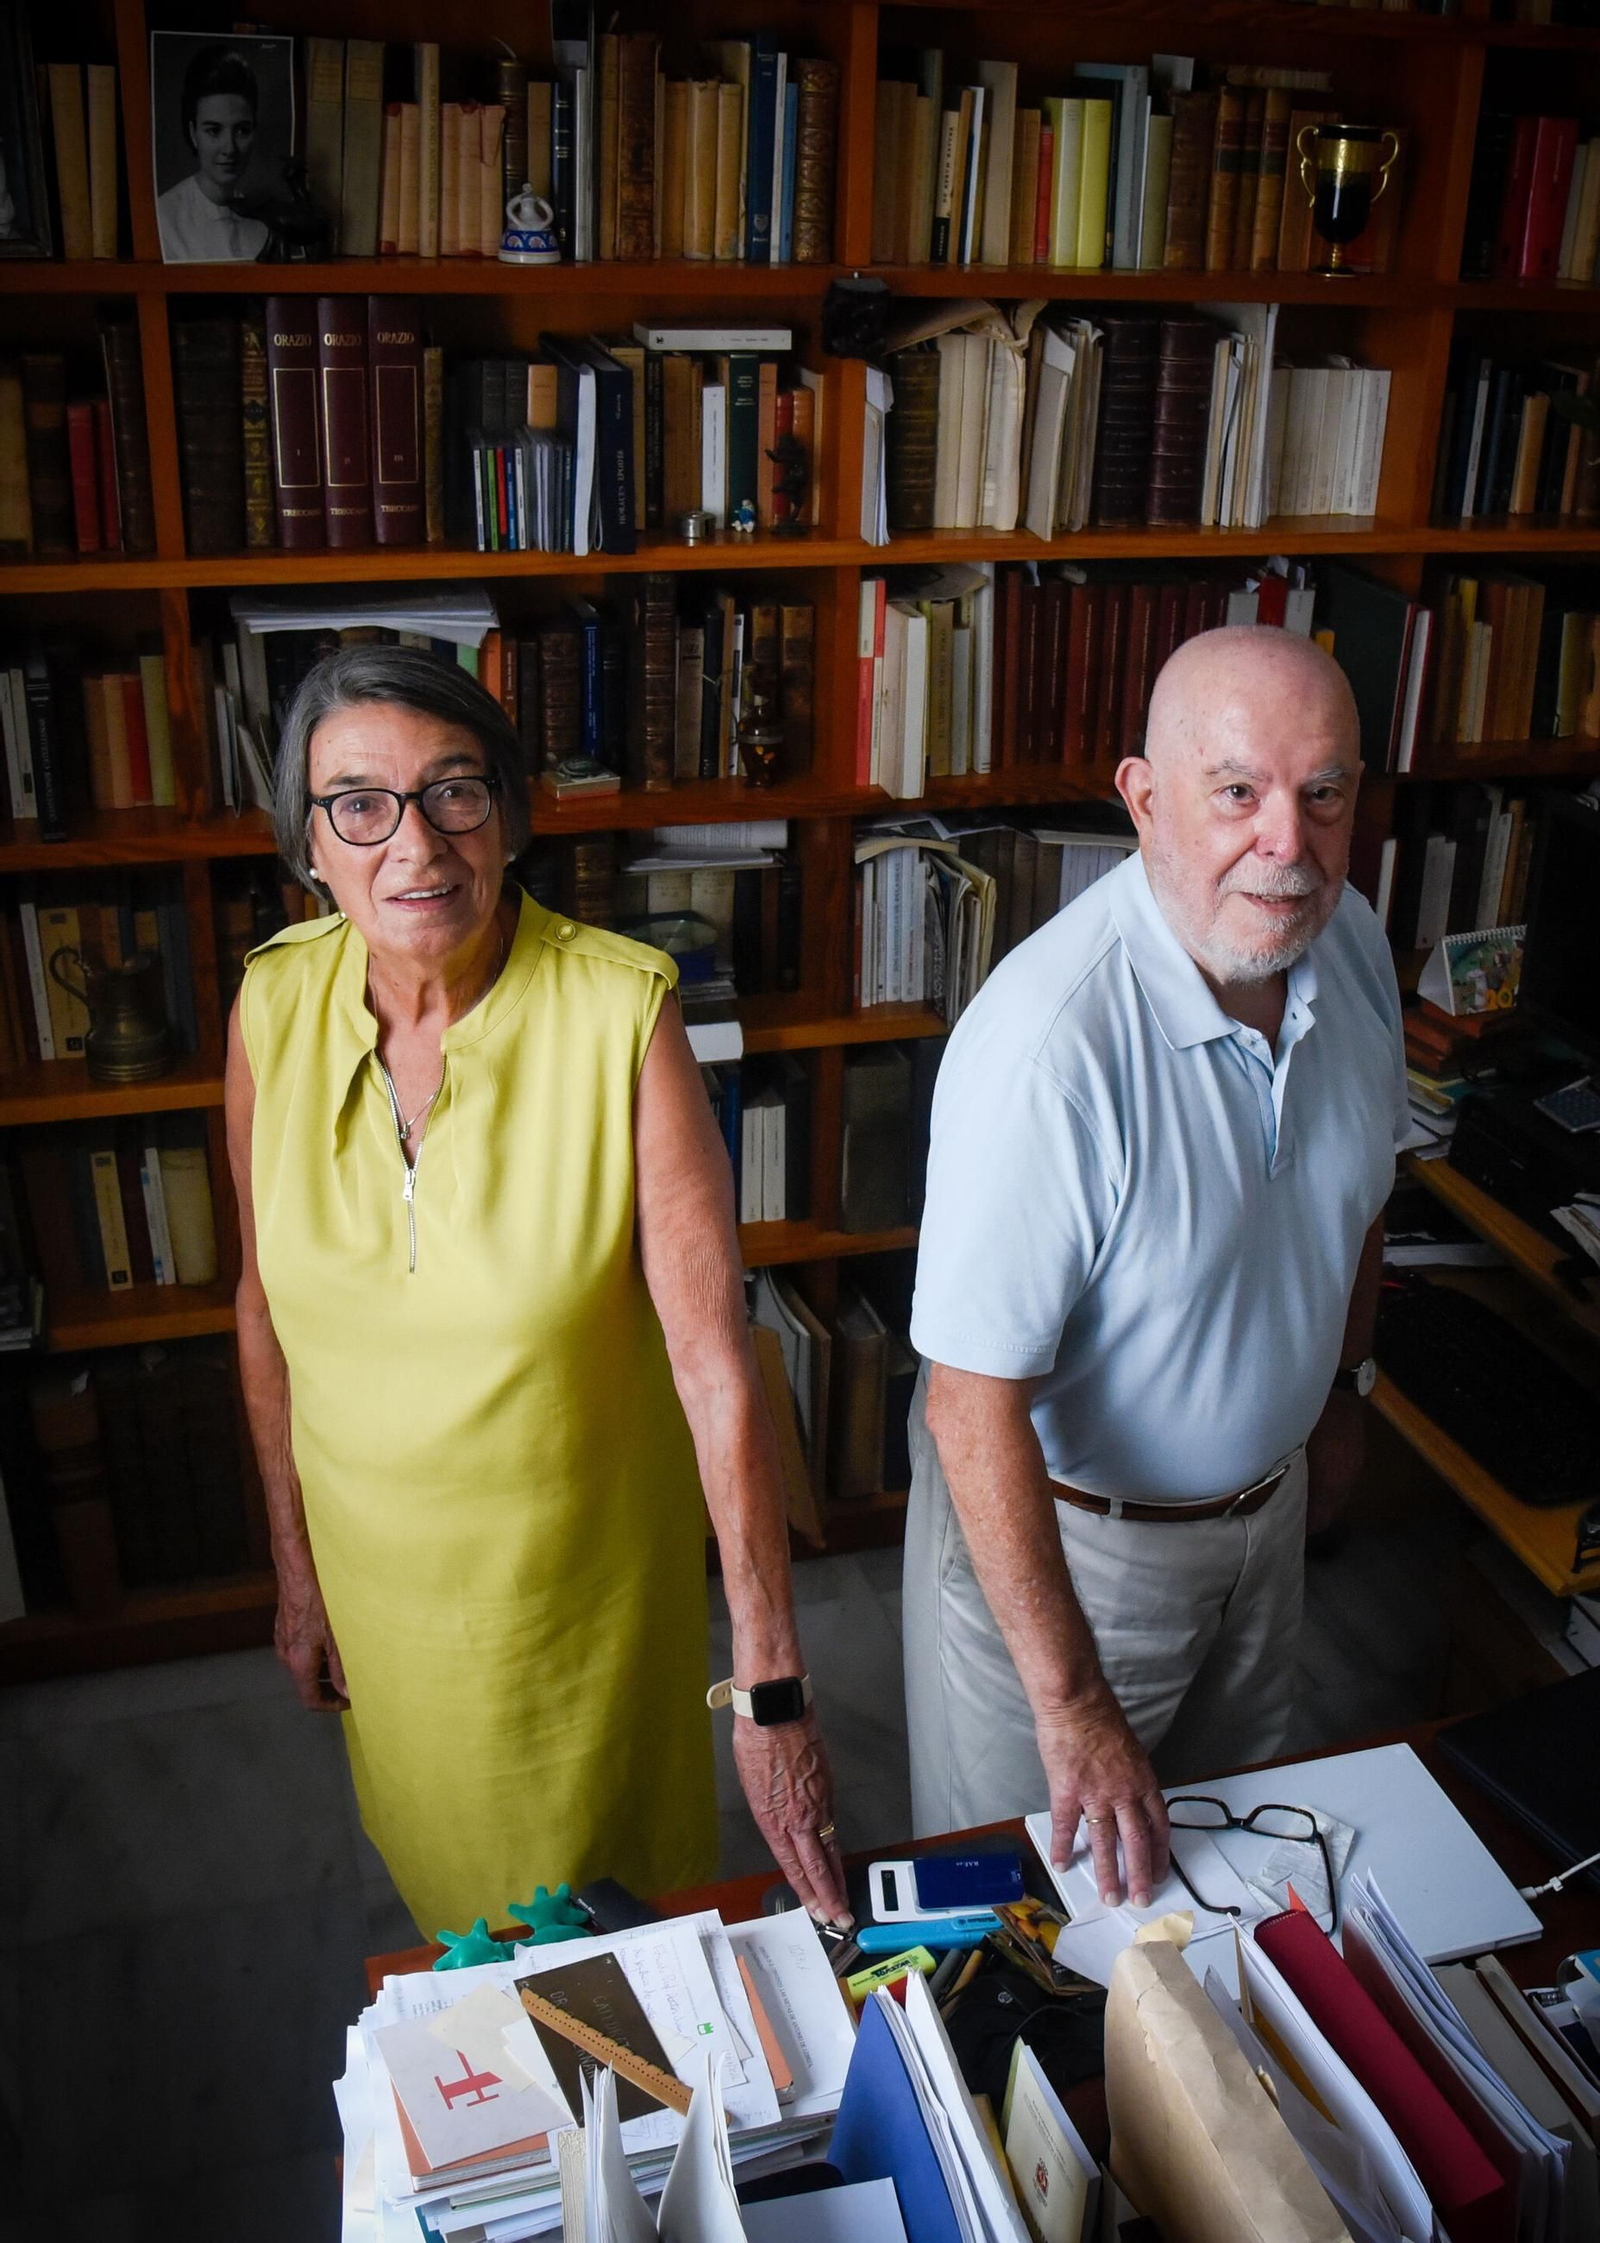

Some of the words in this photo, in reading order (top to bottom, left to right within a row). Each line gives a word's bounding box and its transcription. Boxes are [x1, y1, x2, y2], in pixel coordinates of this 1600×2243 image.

[273, 332, 312, 348] ORAZIO
[323, 332, 362, 347] ORAZIO
[376, 331, 415, 345] ORAZIO
[394, 454, 403, 462] III
[870, 1959, 911, 1978] TOPSTAR
